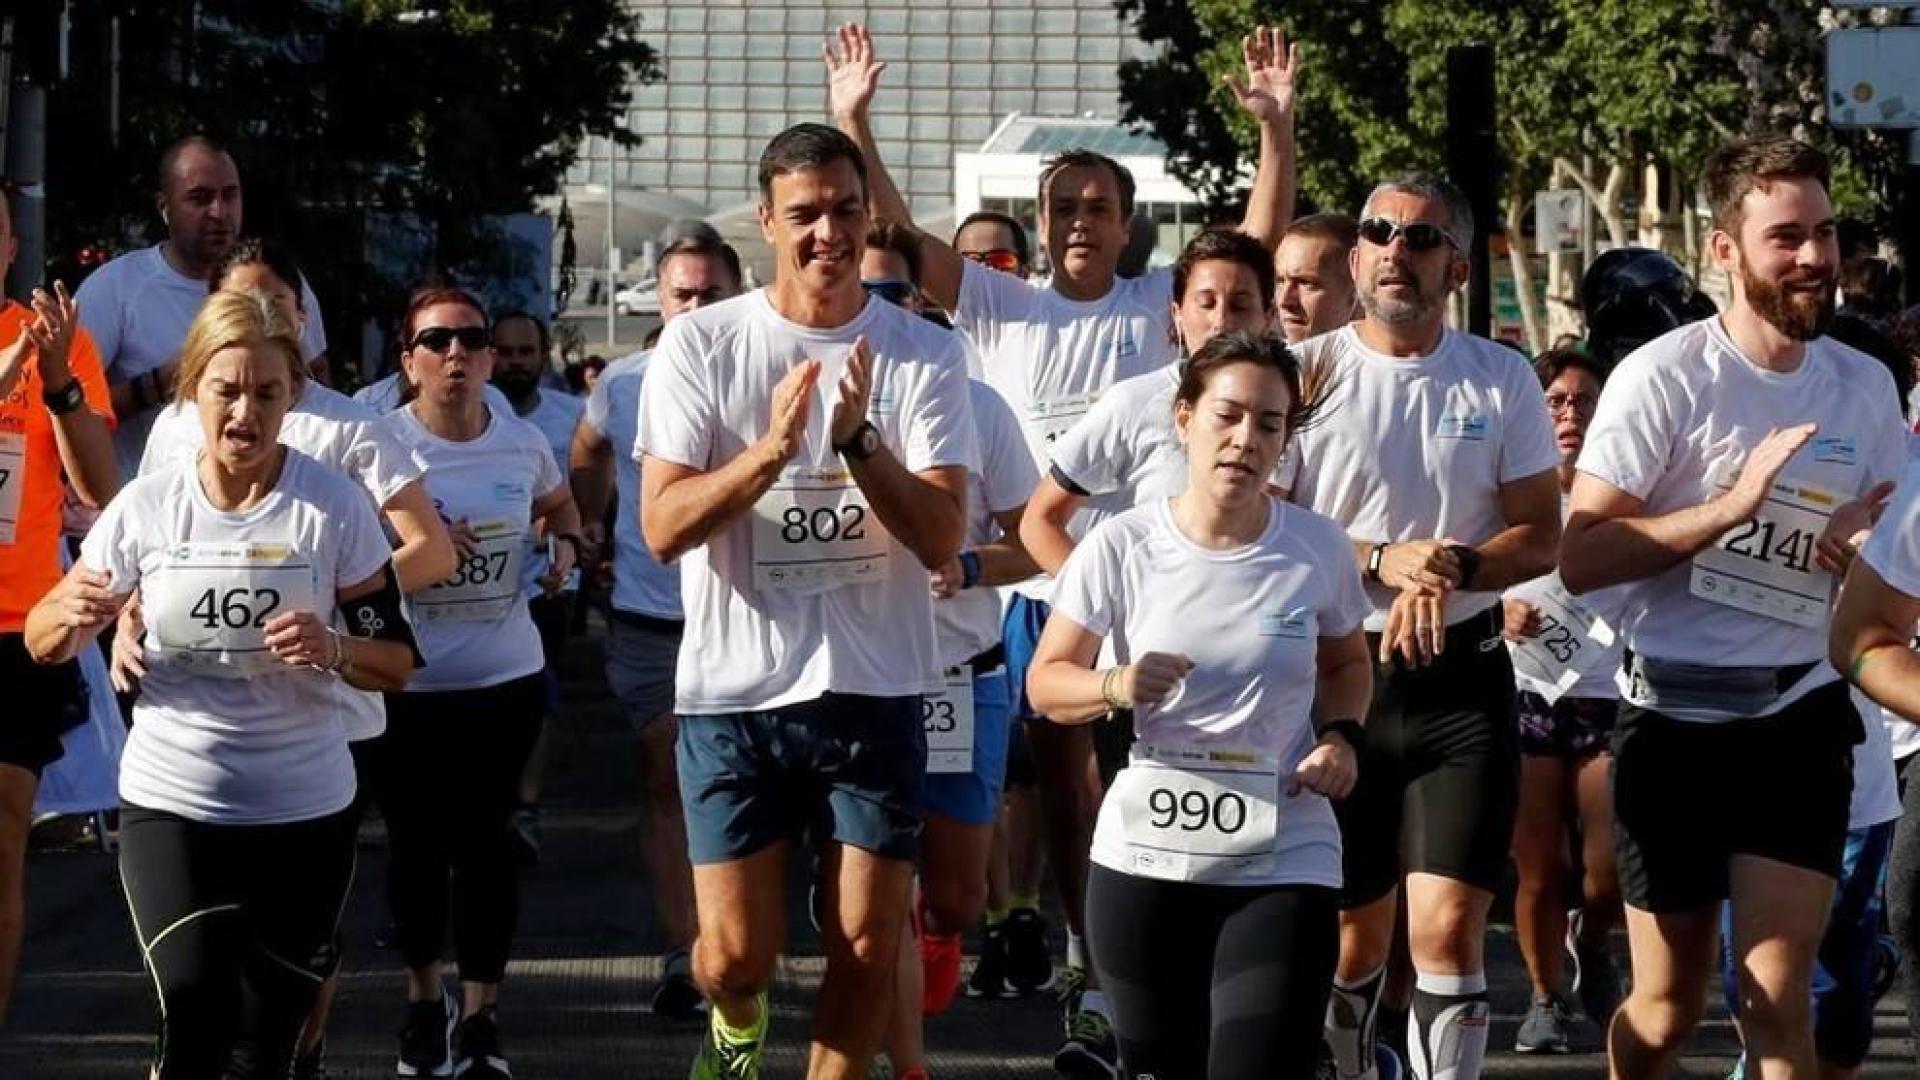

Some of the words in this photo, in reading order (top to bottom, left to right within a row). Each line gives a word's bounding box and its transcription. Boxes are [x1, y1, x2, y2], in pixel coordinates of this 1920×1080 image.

[781, 504, 866, 544] 802
[1725, 517, 1815, 574] 2141
[190, 588, 281, 629] 462
[1536, 606, 1581, 664] 725
[1149, 788, 1246, 834] 990
